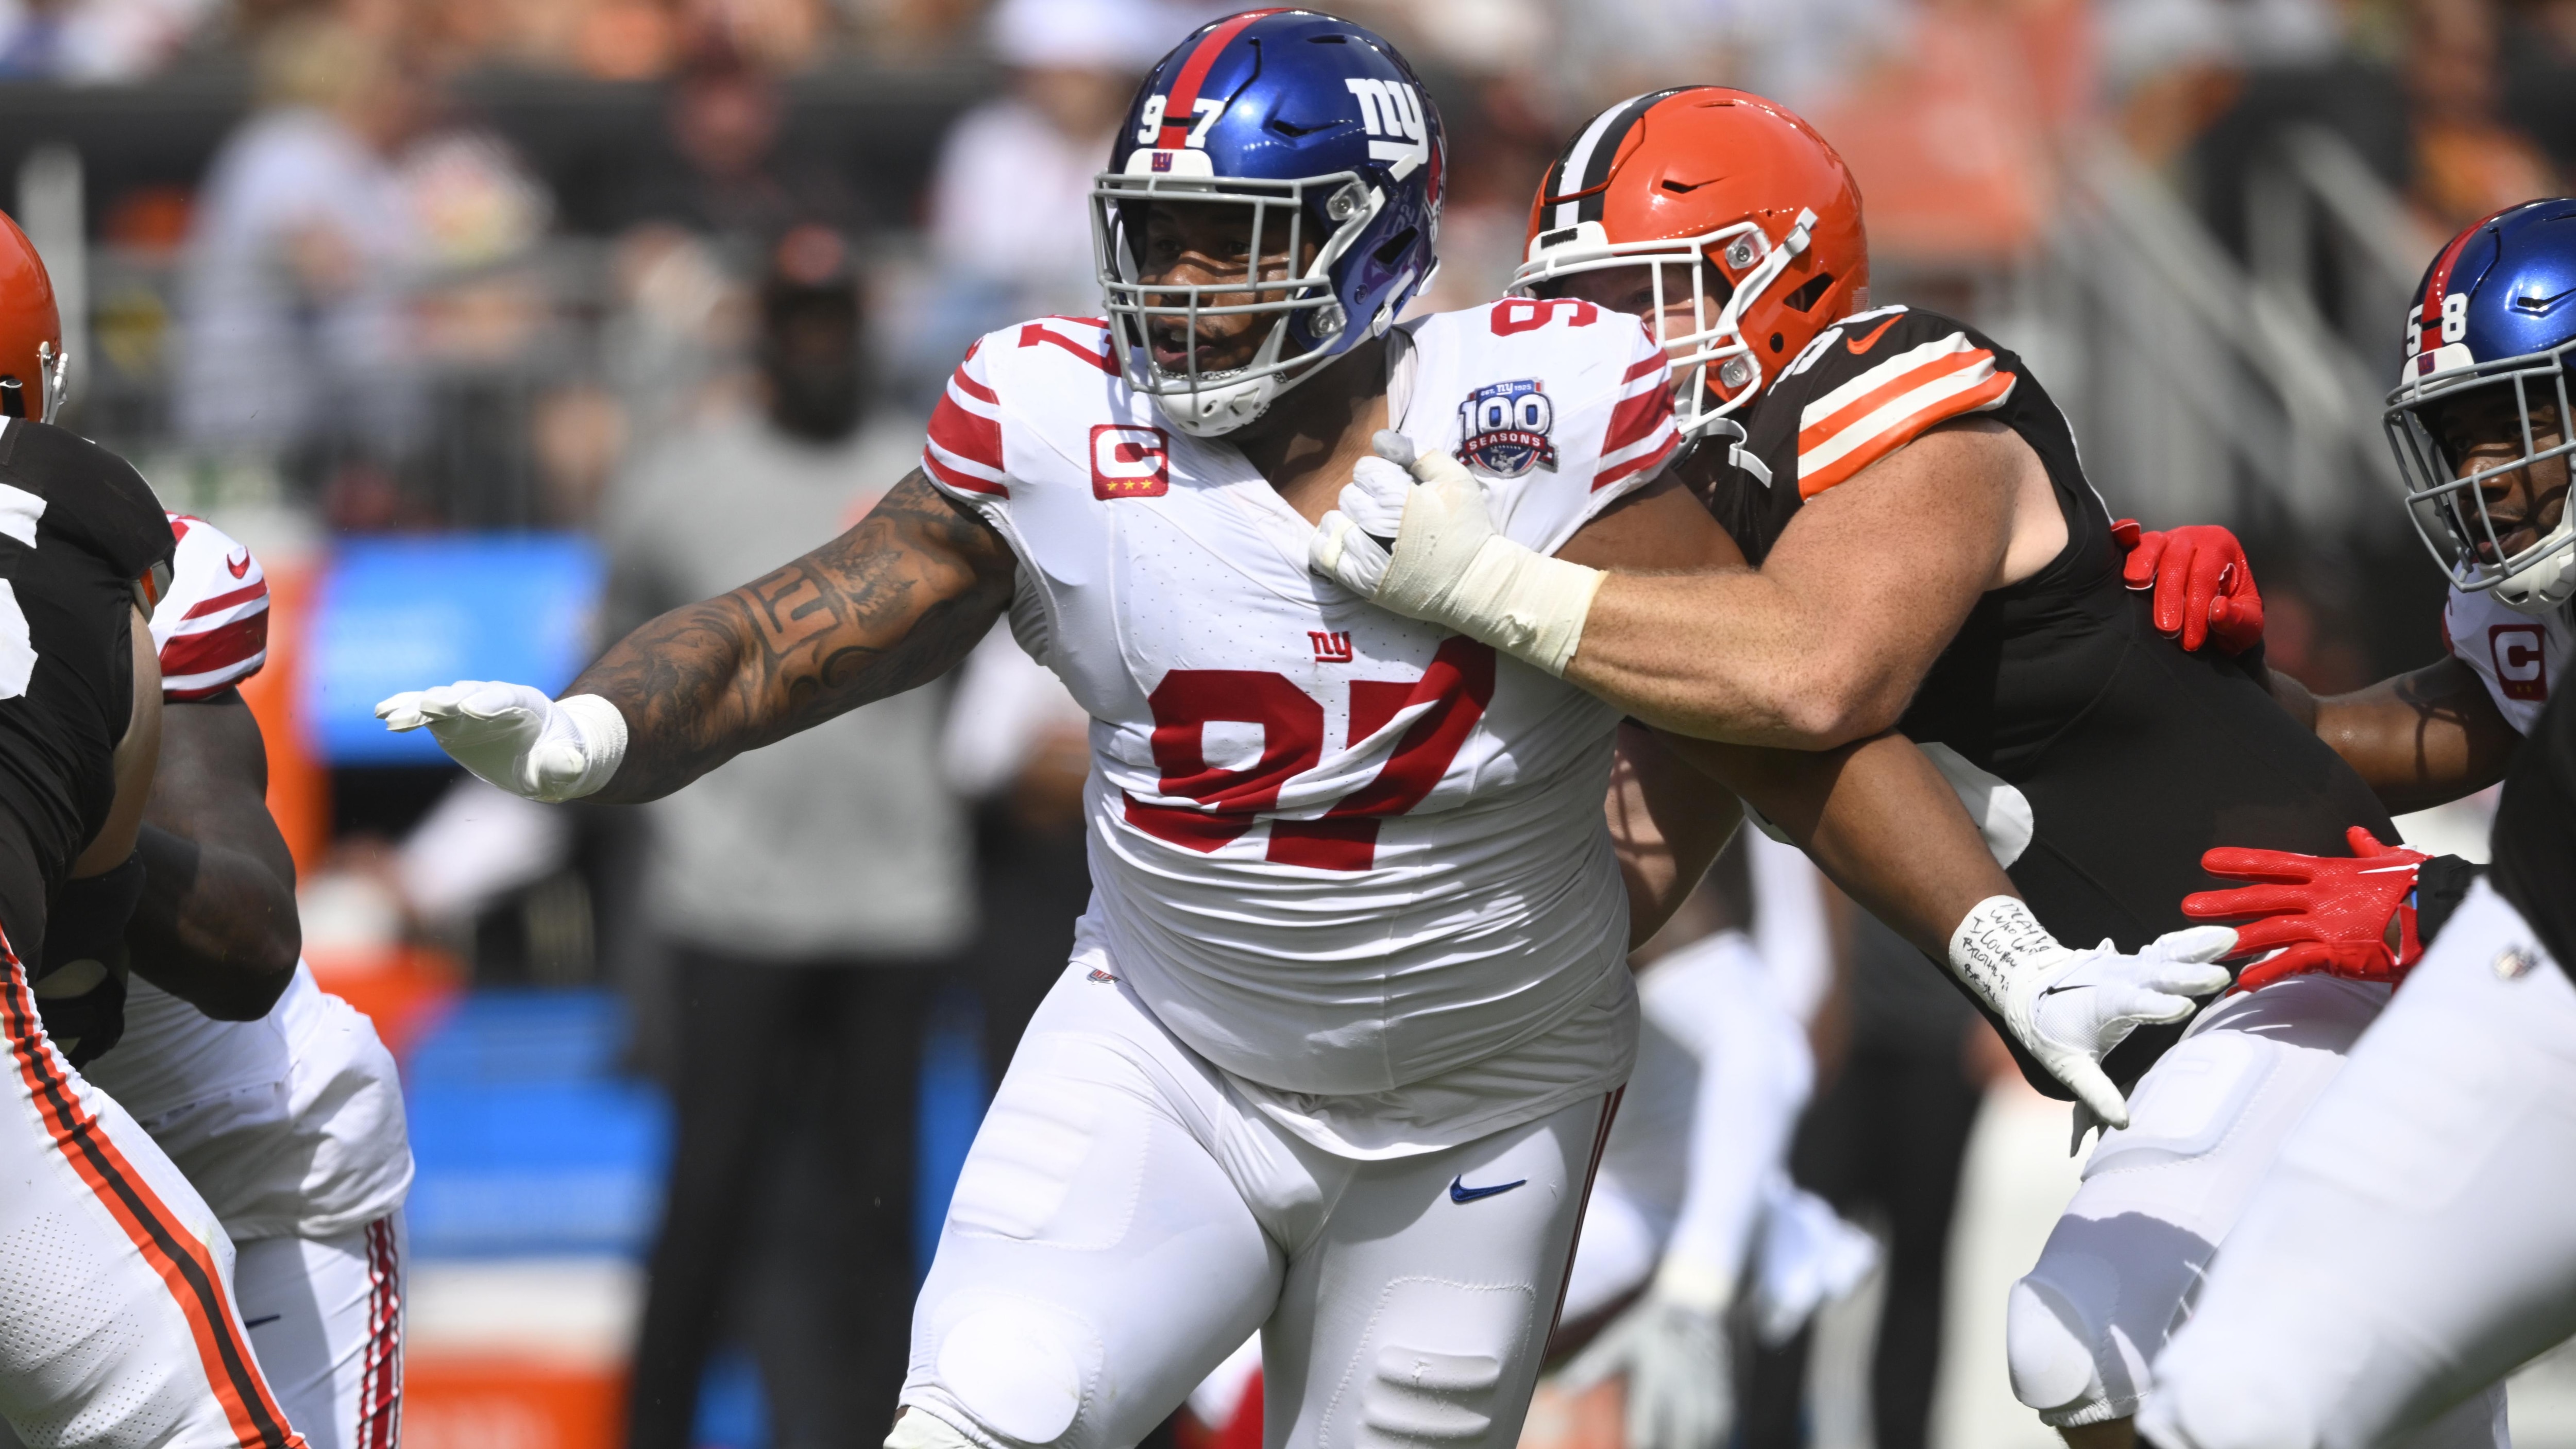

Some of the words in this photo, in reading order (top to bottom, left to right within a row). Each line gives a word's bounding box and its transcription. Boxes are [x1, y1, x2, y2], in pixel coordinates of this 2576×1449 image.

[1460, 394, 1550, 439] 100
[1096, 429, 1162, 478] C
[1469, 433, 1540, 450] SEASONS
[2495, 631, 2540, 680] C
[1122, 634, 1496, 871] 97
